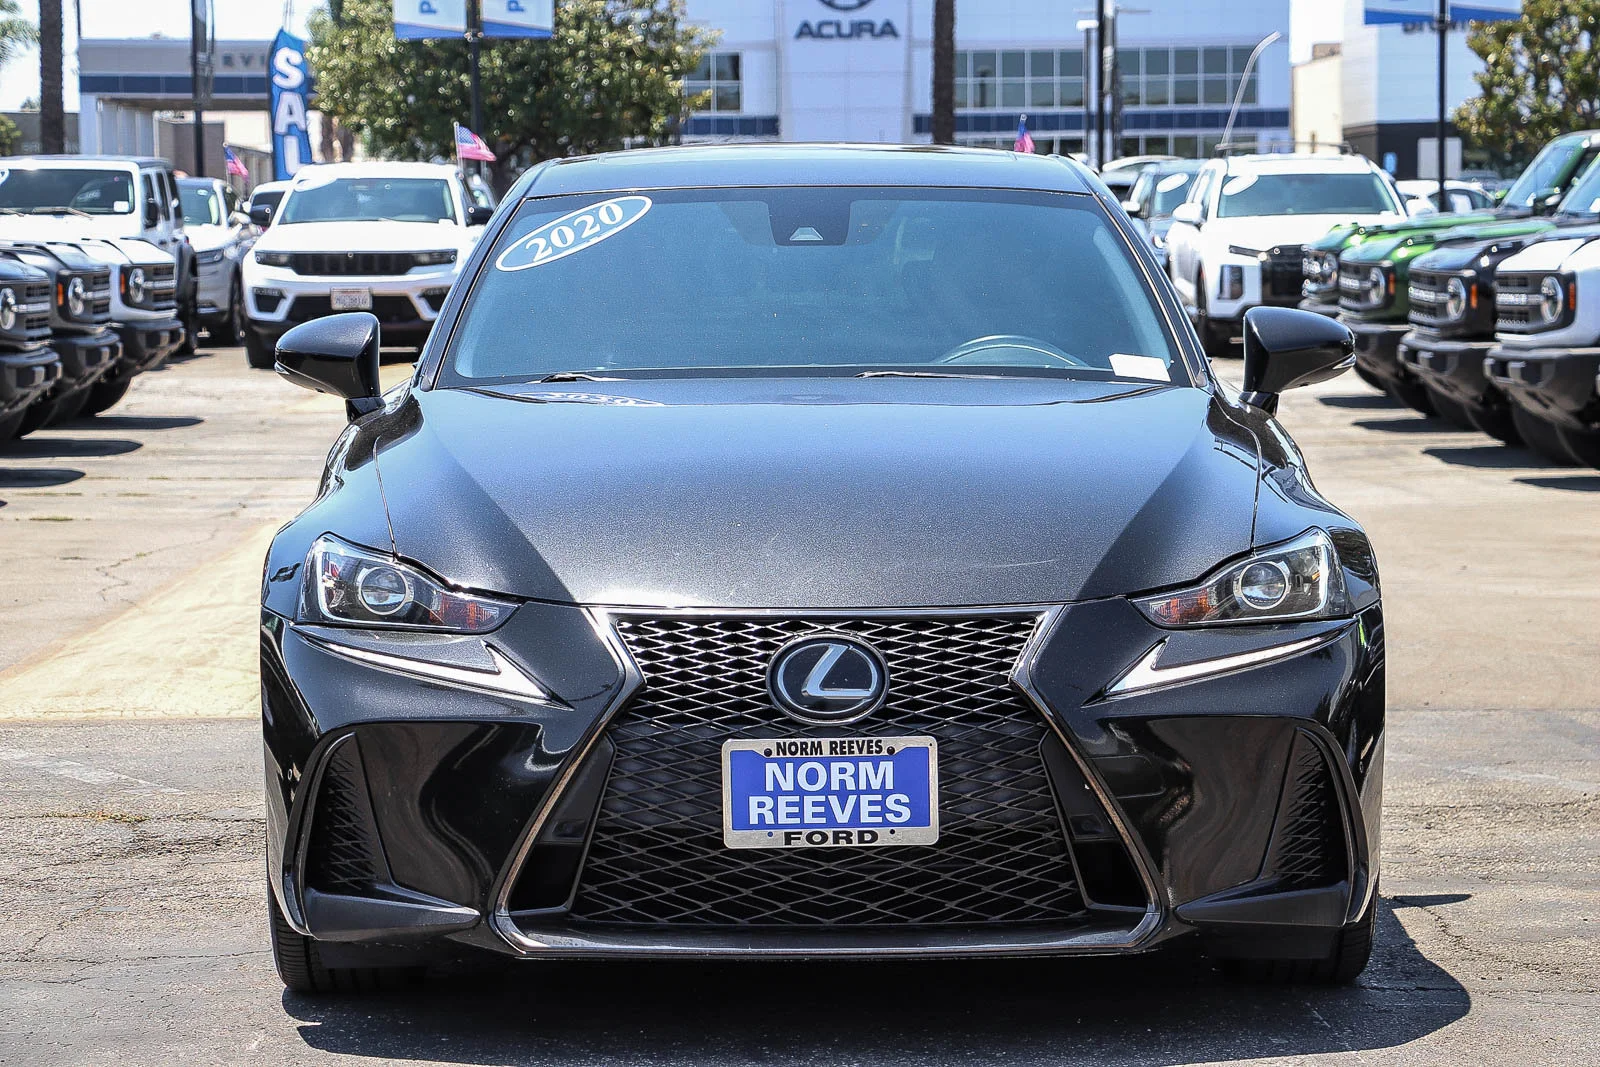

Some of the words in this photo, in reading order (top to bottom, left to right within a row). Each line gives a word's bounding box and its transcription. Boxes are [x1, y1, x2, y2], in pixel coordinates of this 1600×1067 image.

[795, 19, 899, 39] ACURA
[525, 203, 624, 262] 2020
[776, 740, 823, 756] NORM
[829, 739, 883, 755] REEVES
[765, 761, 894, 792] NORM
[748, 793, 911, 825] REEVES
[784, 830, 879, 846] FORD
